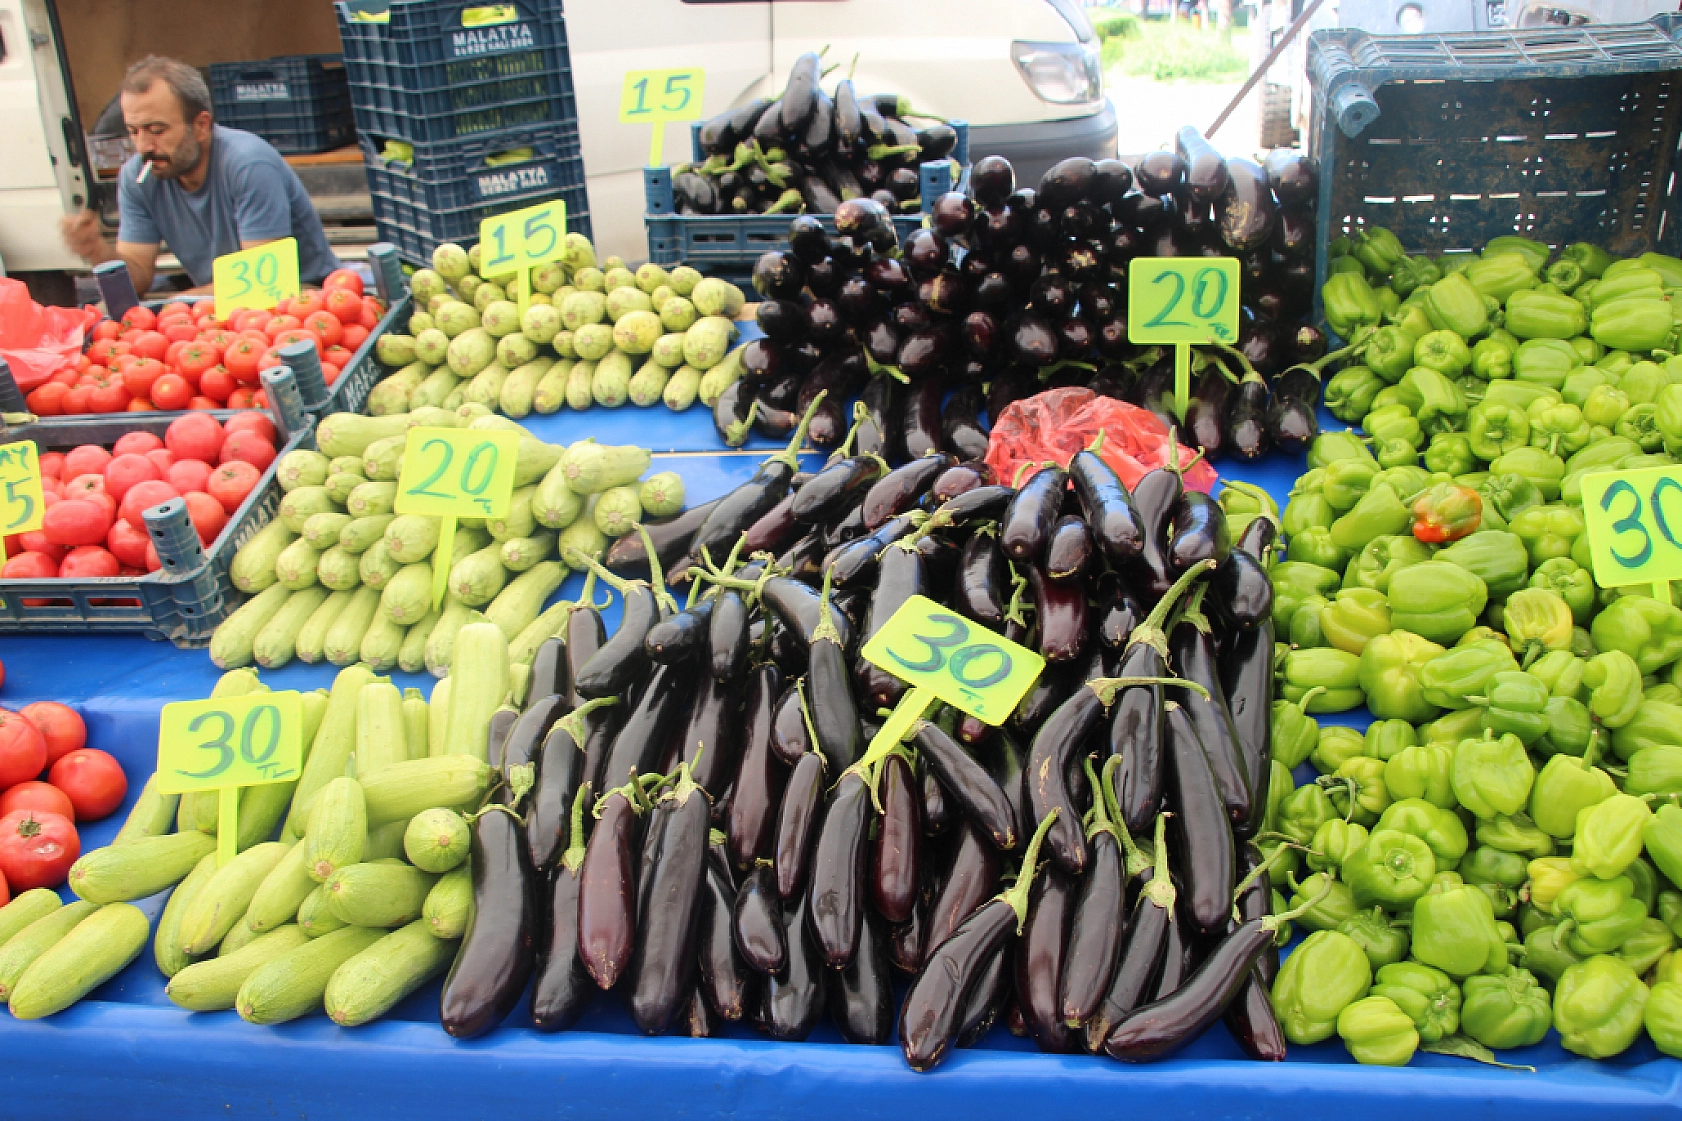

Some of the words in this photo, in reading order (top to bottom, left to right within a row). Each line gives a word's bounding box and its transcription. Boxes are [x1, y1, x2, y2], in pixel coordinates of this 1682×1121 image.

[452, 23, 532, 47] MALATYA
[626, 74, 692, 115] 15
[479, 166, 547, 189] MALATYA
[487, 210, 557, 267] 15
[226, 252, 279, 300] 30
[1142, 267, 1229, 329] 20
[405, 438, 499, 500] 20
[1599, 476, 1682, 569] 30
[885, 613, 1014, 690] 30
[174, 705, 282, 779] 30
[255, 761, 295, 779] TL
